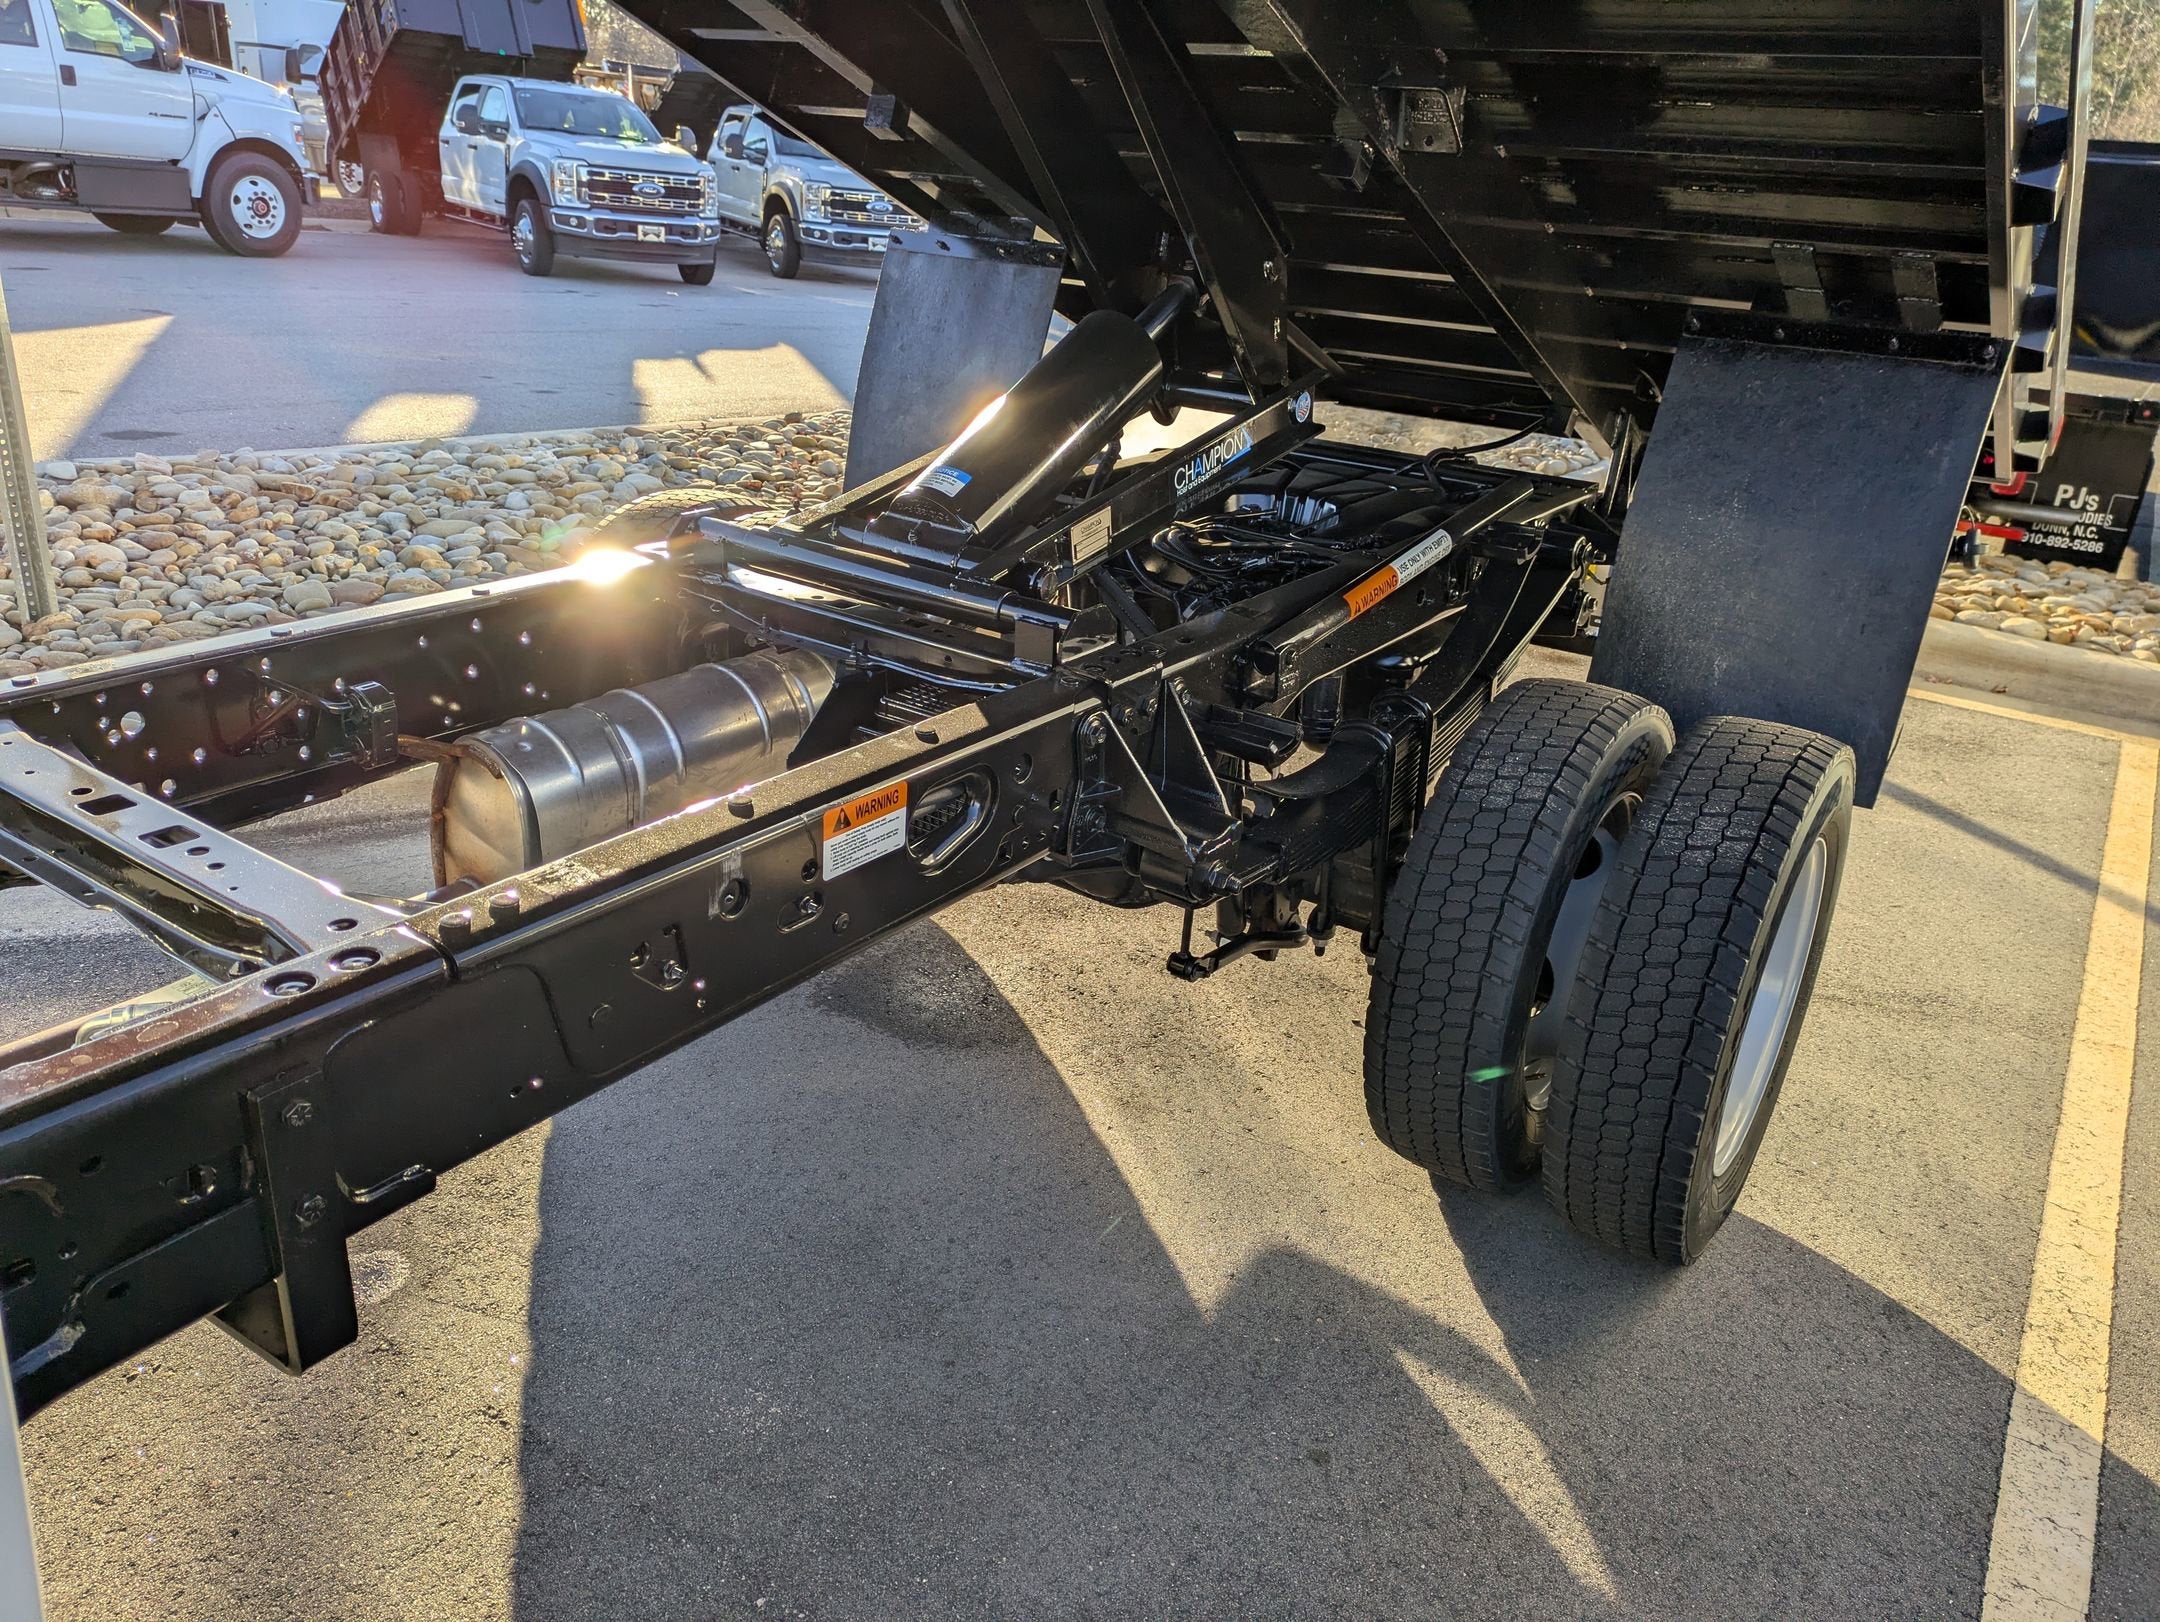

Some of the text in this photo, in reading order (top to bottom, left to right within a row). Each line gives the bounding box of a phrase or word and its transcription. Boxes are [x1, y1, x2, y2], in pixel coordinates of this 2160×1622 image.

[1174, 430, 1244, 490] CHAMPION
[1187, 478, 1198, 490] and
[1198, 463, 1222, 484] Equipment
[2021, 531, 2104, 554] 910-892-5286
[2072, 524, 2099, 540] N.C.
[1397, 533, 1448, 575] USE ONLY WITH EMPTY
[1361, 574, 1398, 608] WARNING
[855, 789, 899, 820] WARNING
